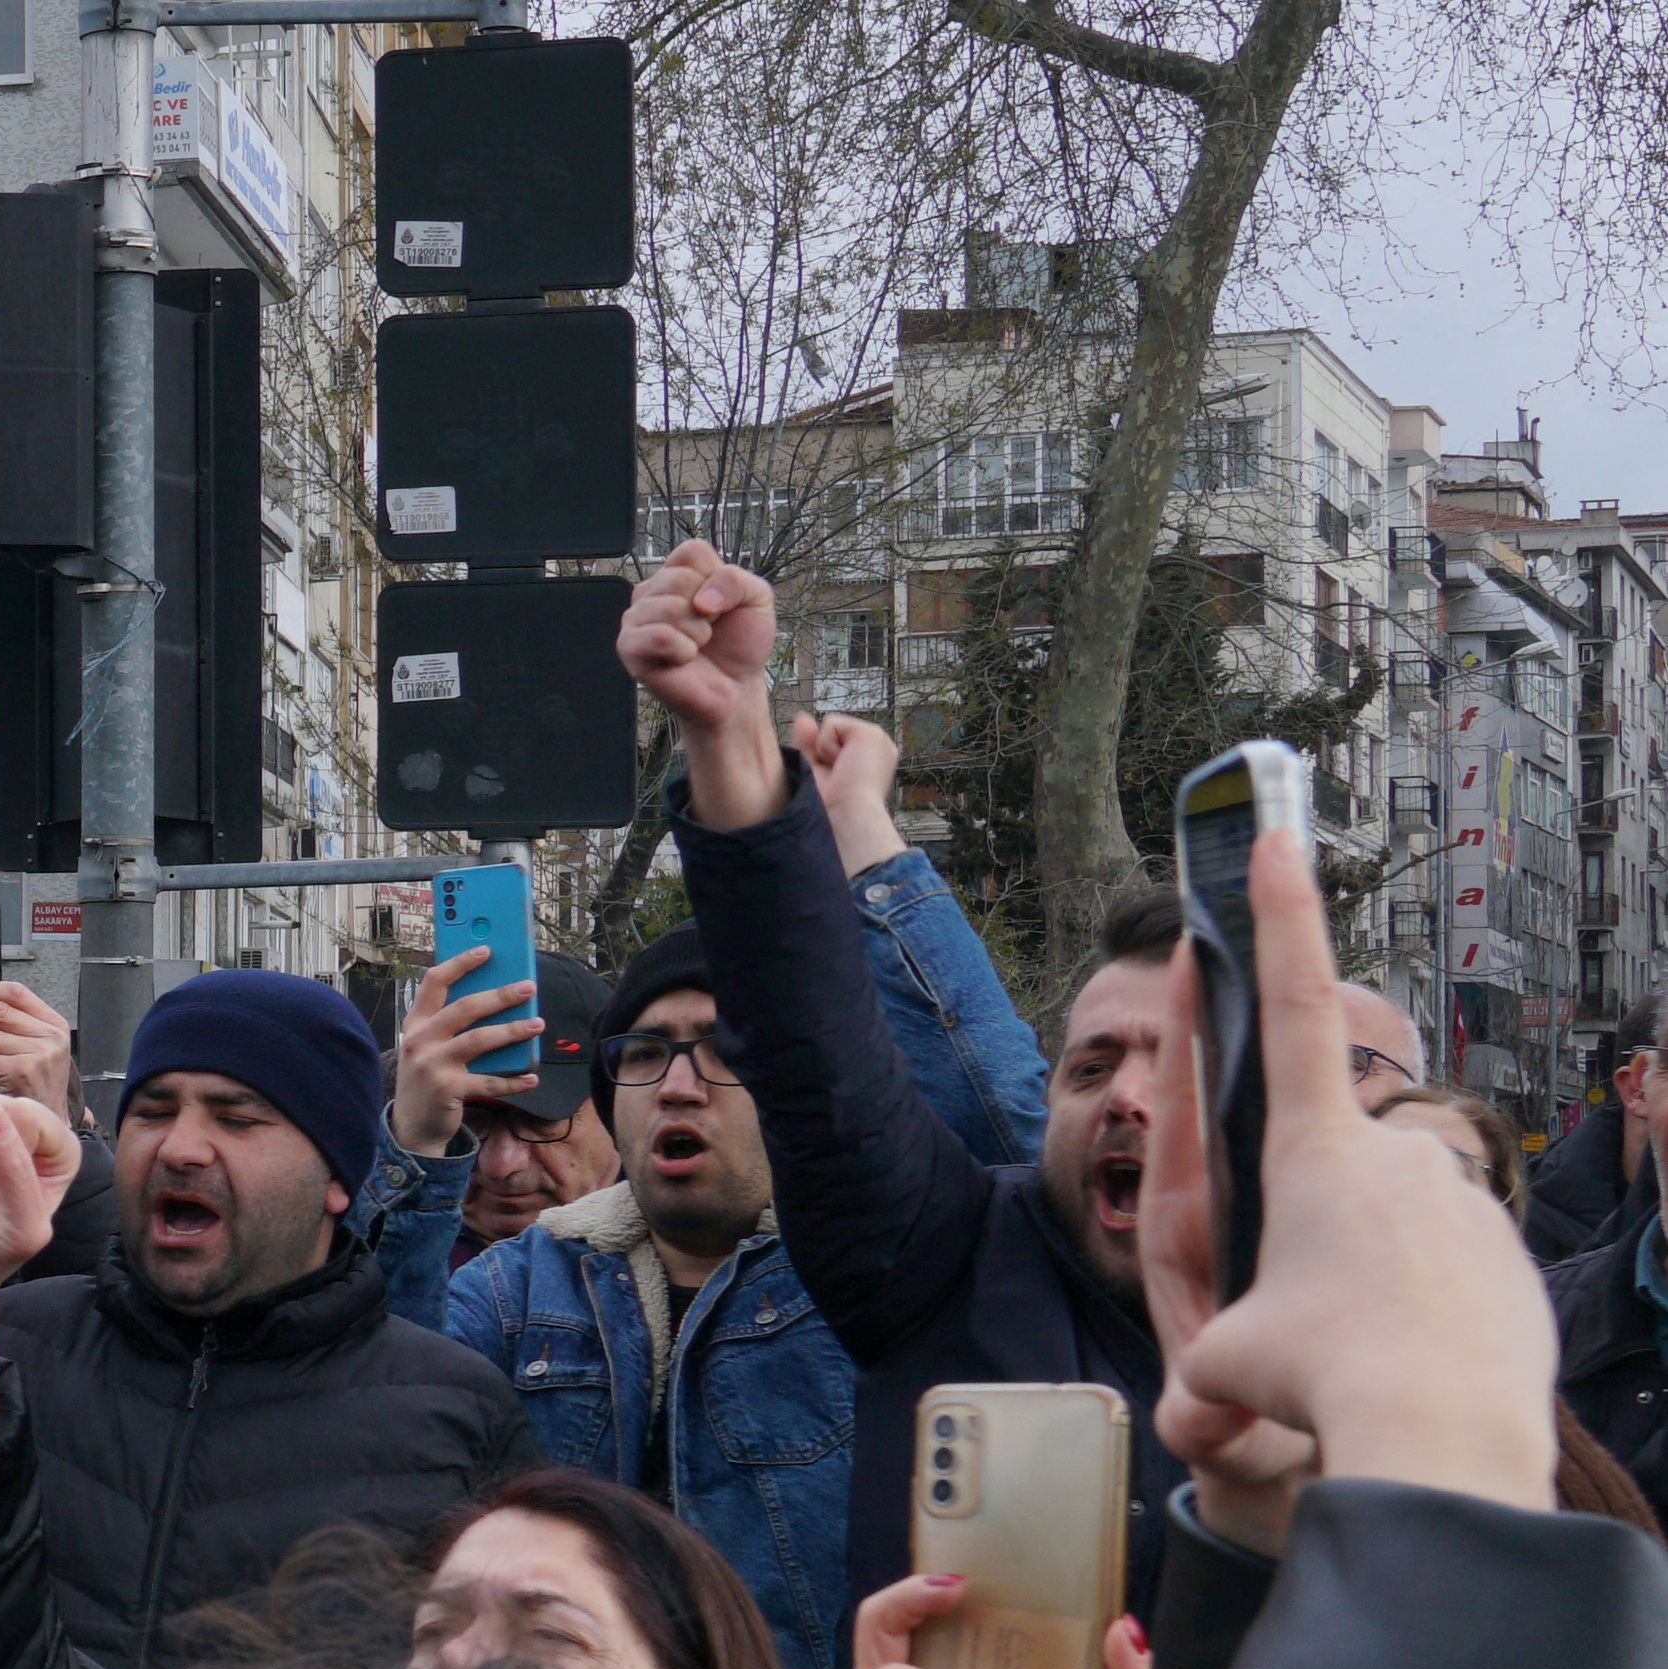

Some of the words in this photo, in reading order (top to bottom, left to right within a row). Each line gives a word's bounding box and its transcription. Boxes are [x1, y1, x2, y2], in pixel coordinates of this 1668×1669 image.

[153, 81, 191, 94] Bedir
[168, 98, 188, 110] VE
[153, 114, 181, 126] RE
[166, 132, 177, 141] 34
[180, 131, 190, 140] 63
[35, 906, 62, 915] ALBAY
[34, 917, 73, 925] SAKARYA
